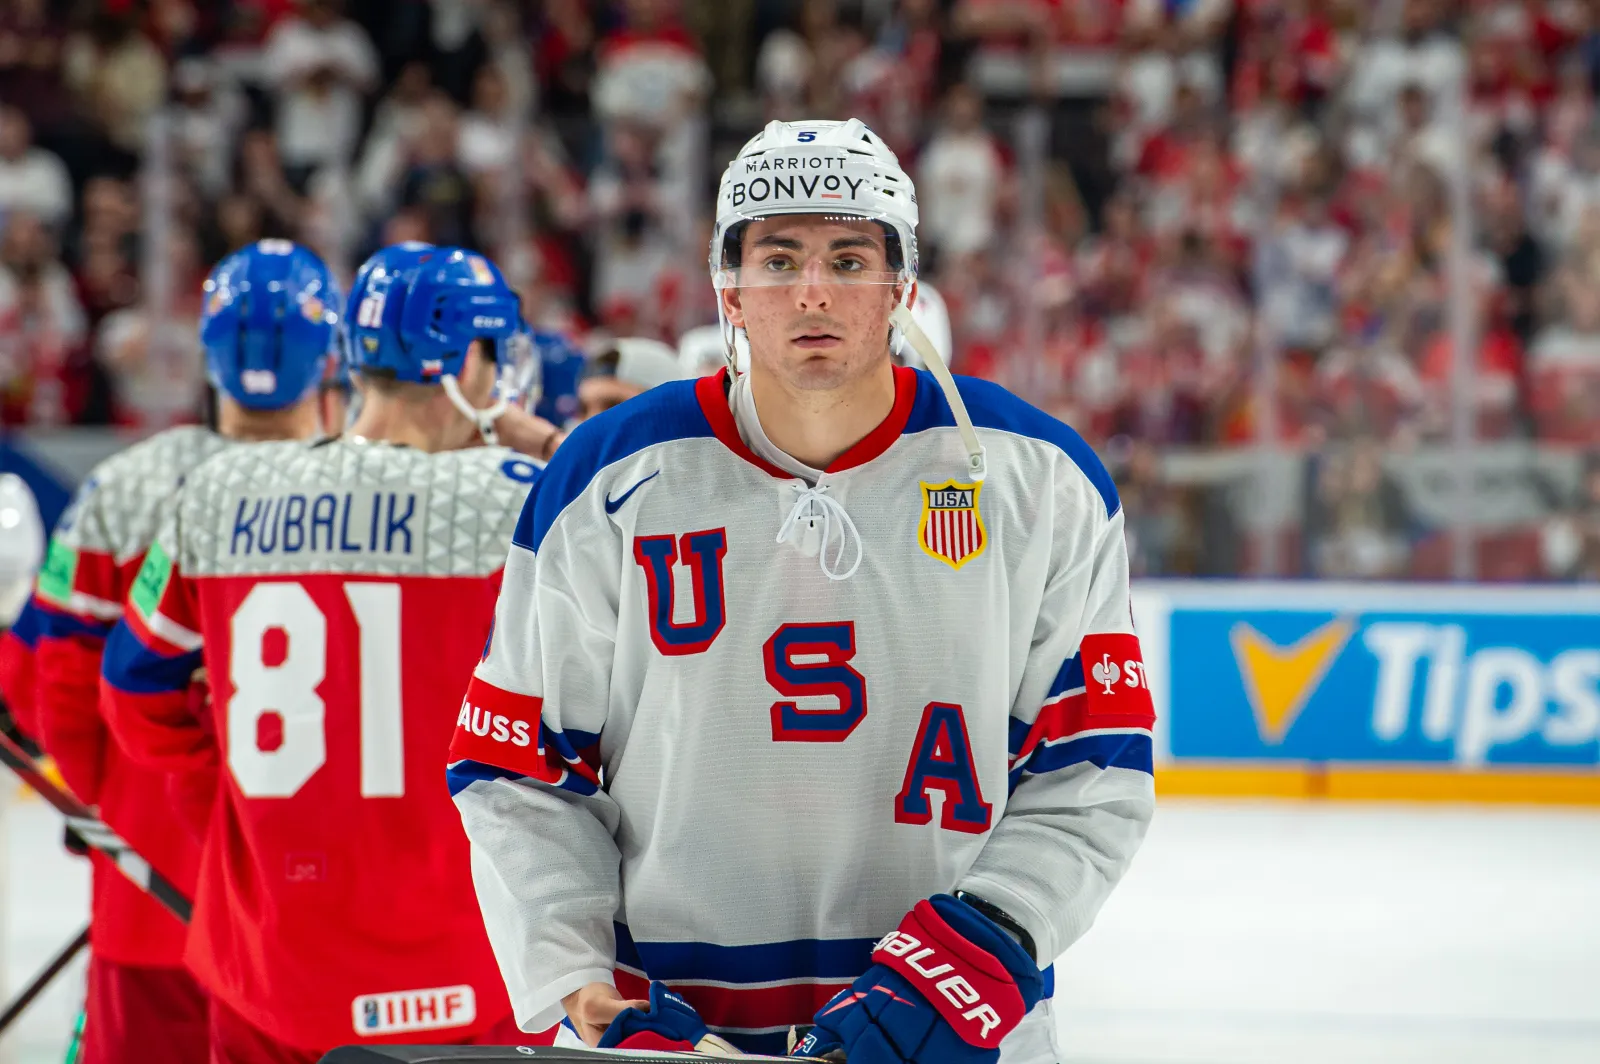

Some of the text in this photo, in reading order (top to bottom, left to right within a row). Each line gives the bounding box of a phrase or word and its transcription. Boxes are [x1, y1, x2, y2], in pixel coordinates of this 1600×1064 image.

[797, 131, 818, 143] 5
[746, 157, 847, 174] MARRIOTT
[733, 175, 864, 207] BONVOY
[934, 491, 969, 507] USA
[230, 493, 416, 556] KUBALIK
[228, 582, 405, 799] 81
[1123, 659, 1148, 690] ST
[1363, 620, 1600, 770] Tips
[457, 696, 531, 747] AUSS
[387, 992, 463, 1025] IIHF
